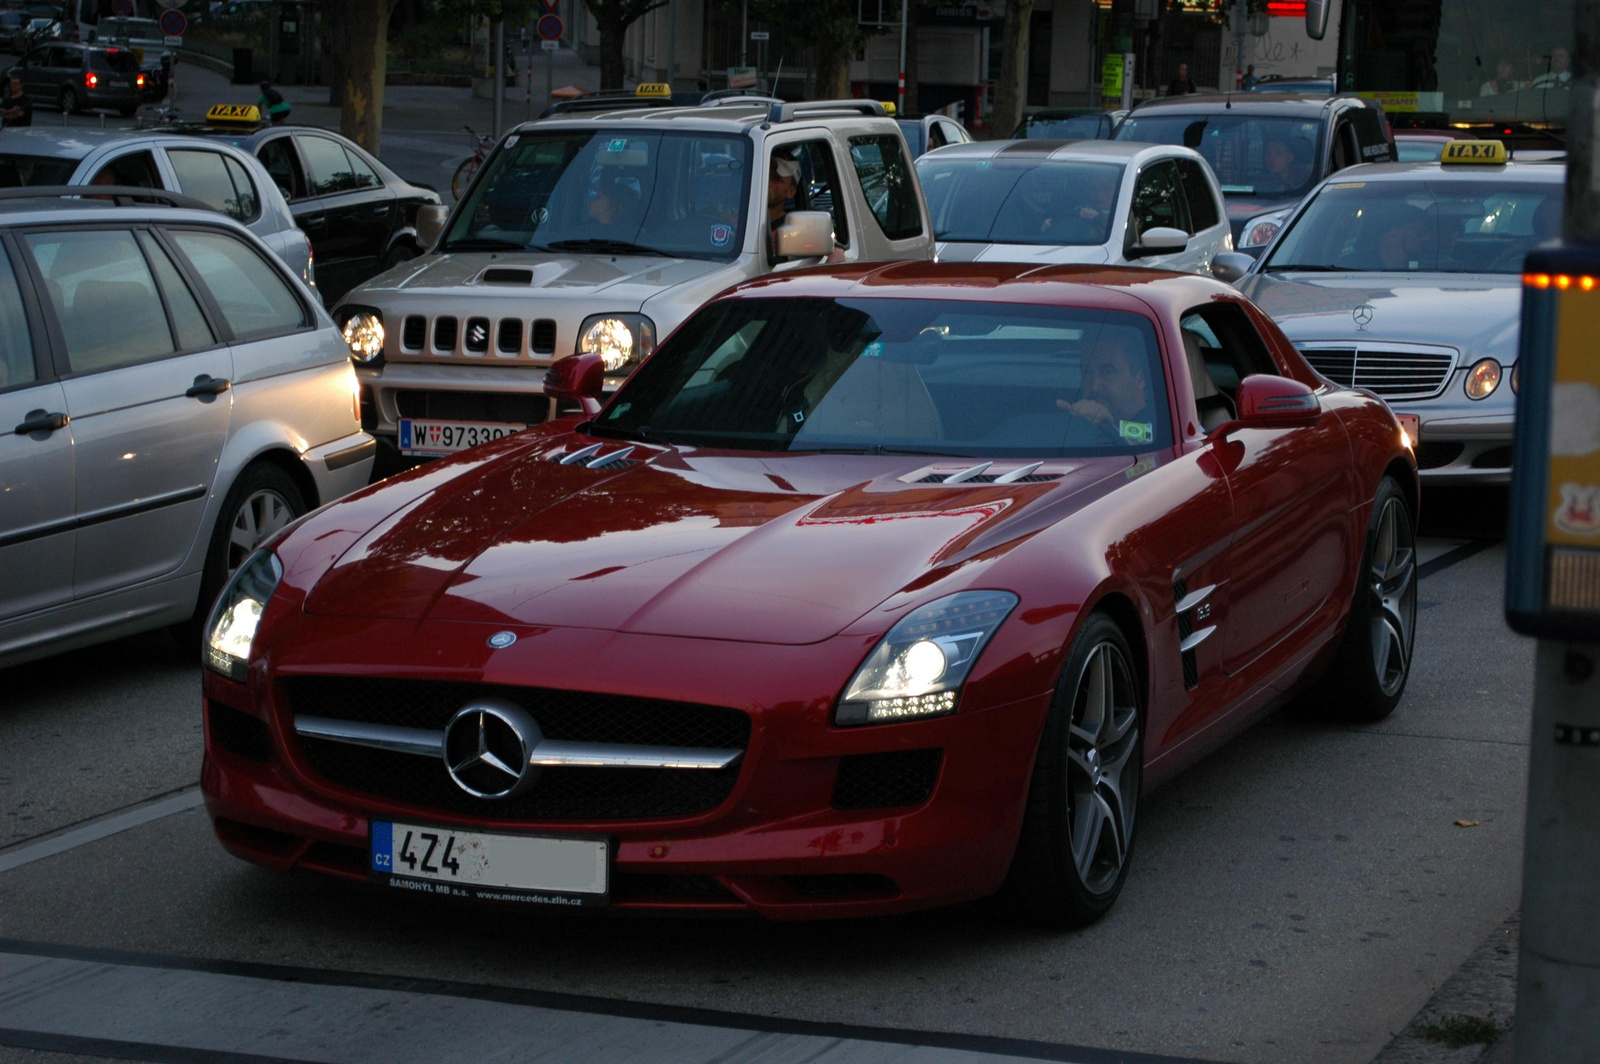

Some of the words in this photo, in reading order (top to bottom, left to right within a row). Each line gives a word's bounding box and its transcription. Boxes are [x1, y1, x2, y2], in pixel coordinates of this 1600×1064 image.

[936, 7, 972, 17] IMBISS
[640, 84, 664, 93] TAXI
[213, 104, 252, 116] TAXI
[1450, 144, 1495, 158] TAXI
[414, 424, 427, 446] W
[375, 853, 390, 866] CZ
[400, 831, 459, 876] 4Z4
[435, 885, 451, 895] MB
[452, 889, 470, 897] a.s.
[476, 890, 582, 906] www.mercedes.zlin.cz
